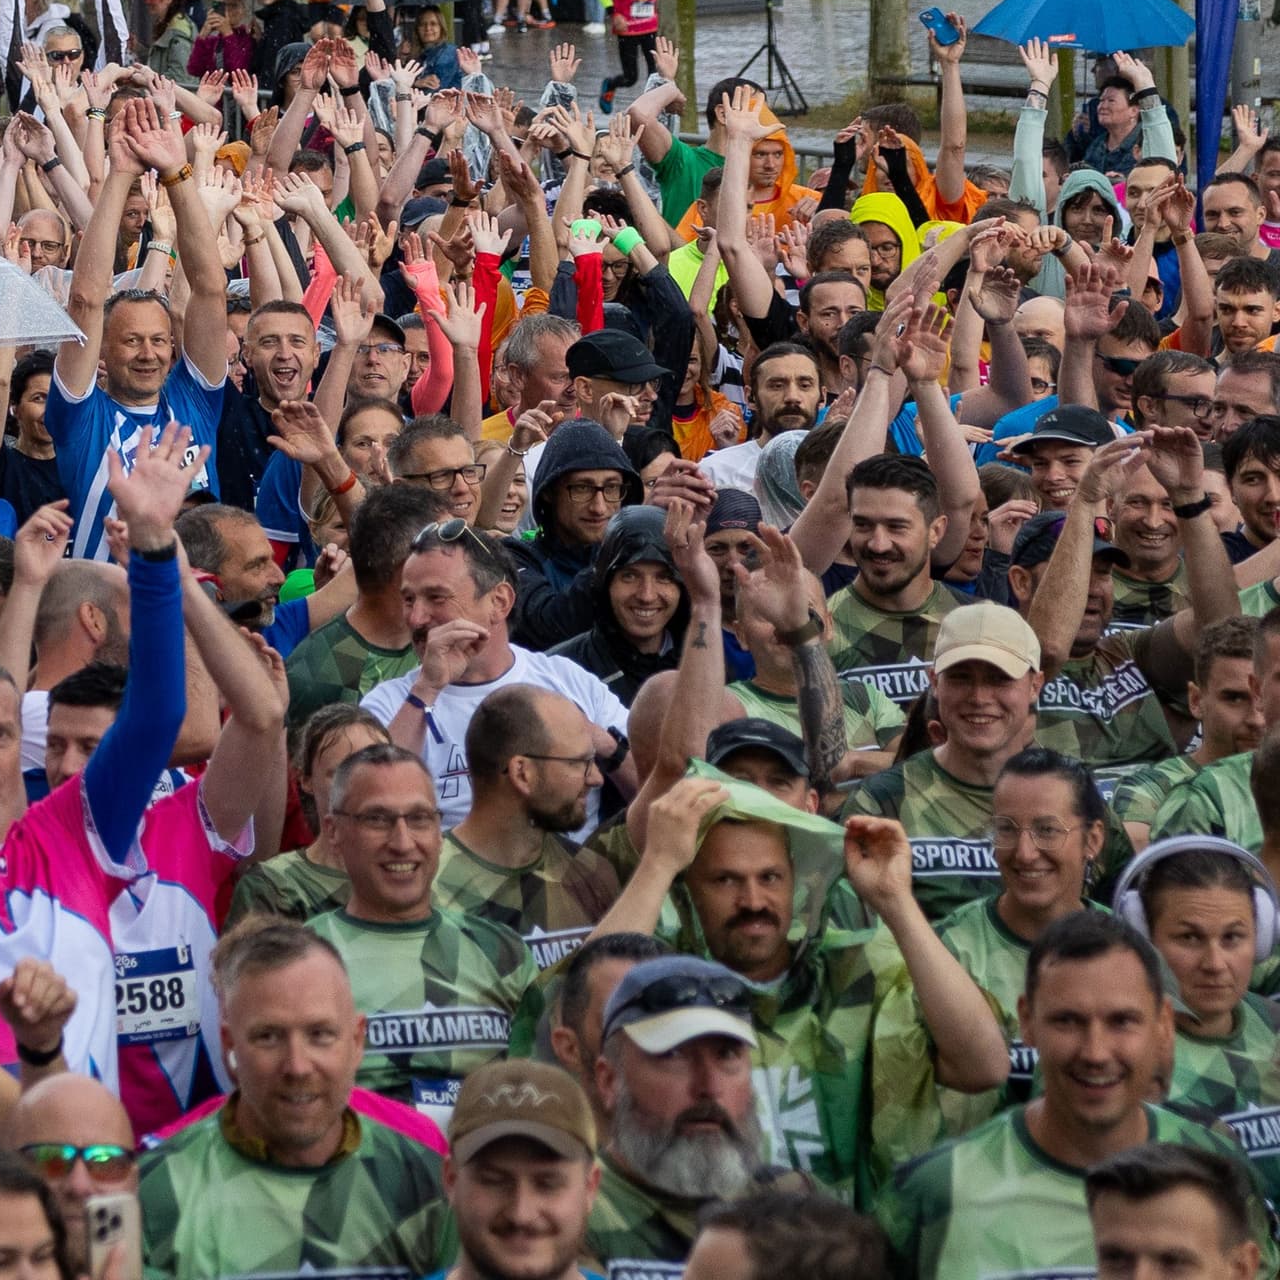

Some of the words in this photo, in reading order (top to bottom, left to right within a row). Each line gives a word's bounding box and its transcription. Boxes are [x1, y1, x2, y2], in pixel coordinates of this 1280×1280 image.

[848, 670, 931, 695] ORTKA
[912, 844, 999, 869] SPORTK
[421, 1091, 458, 1105] RUN
